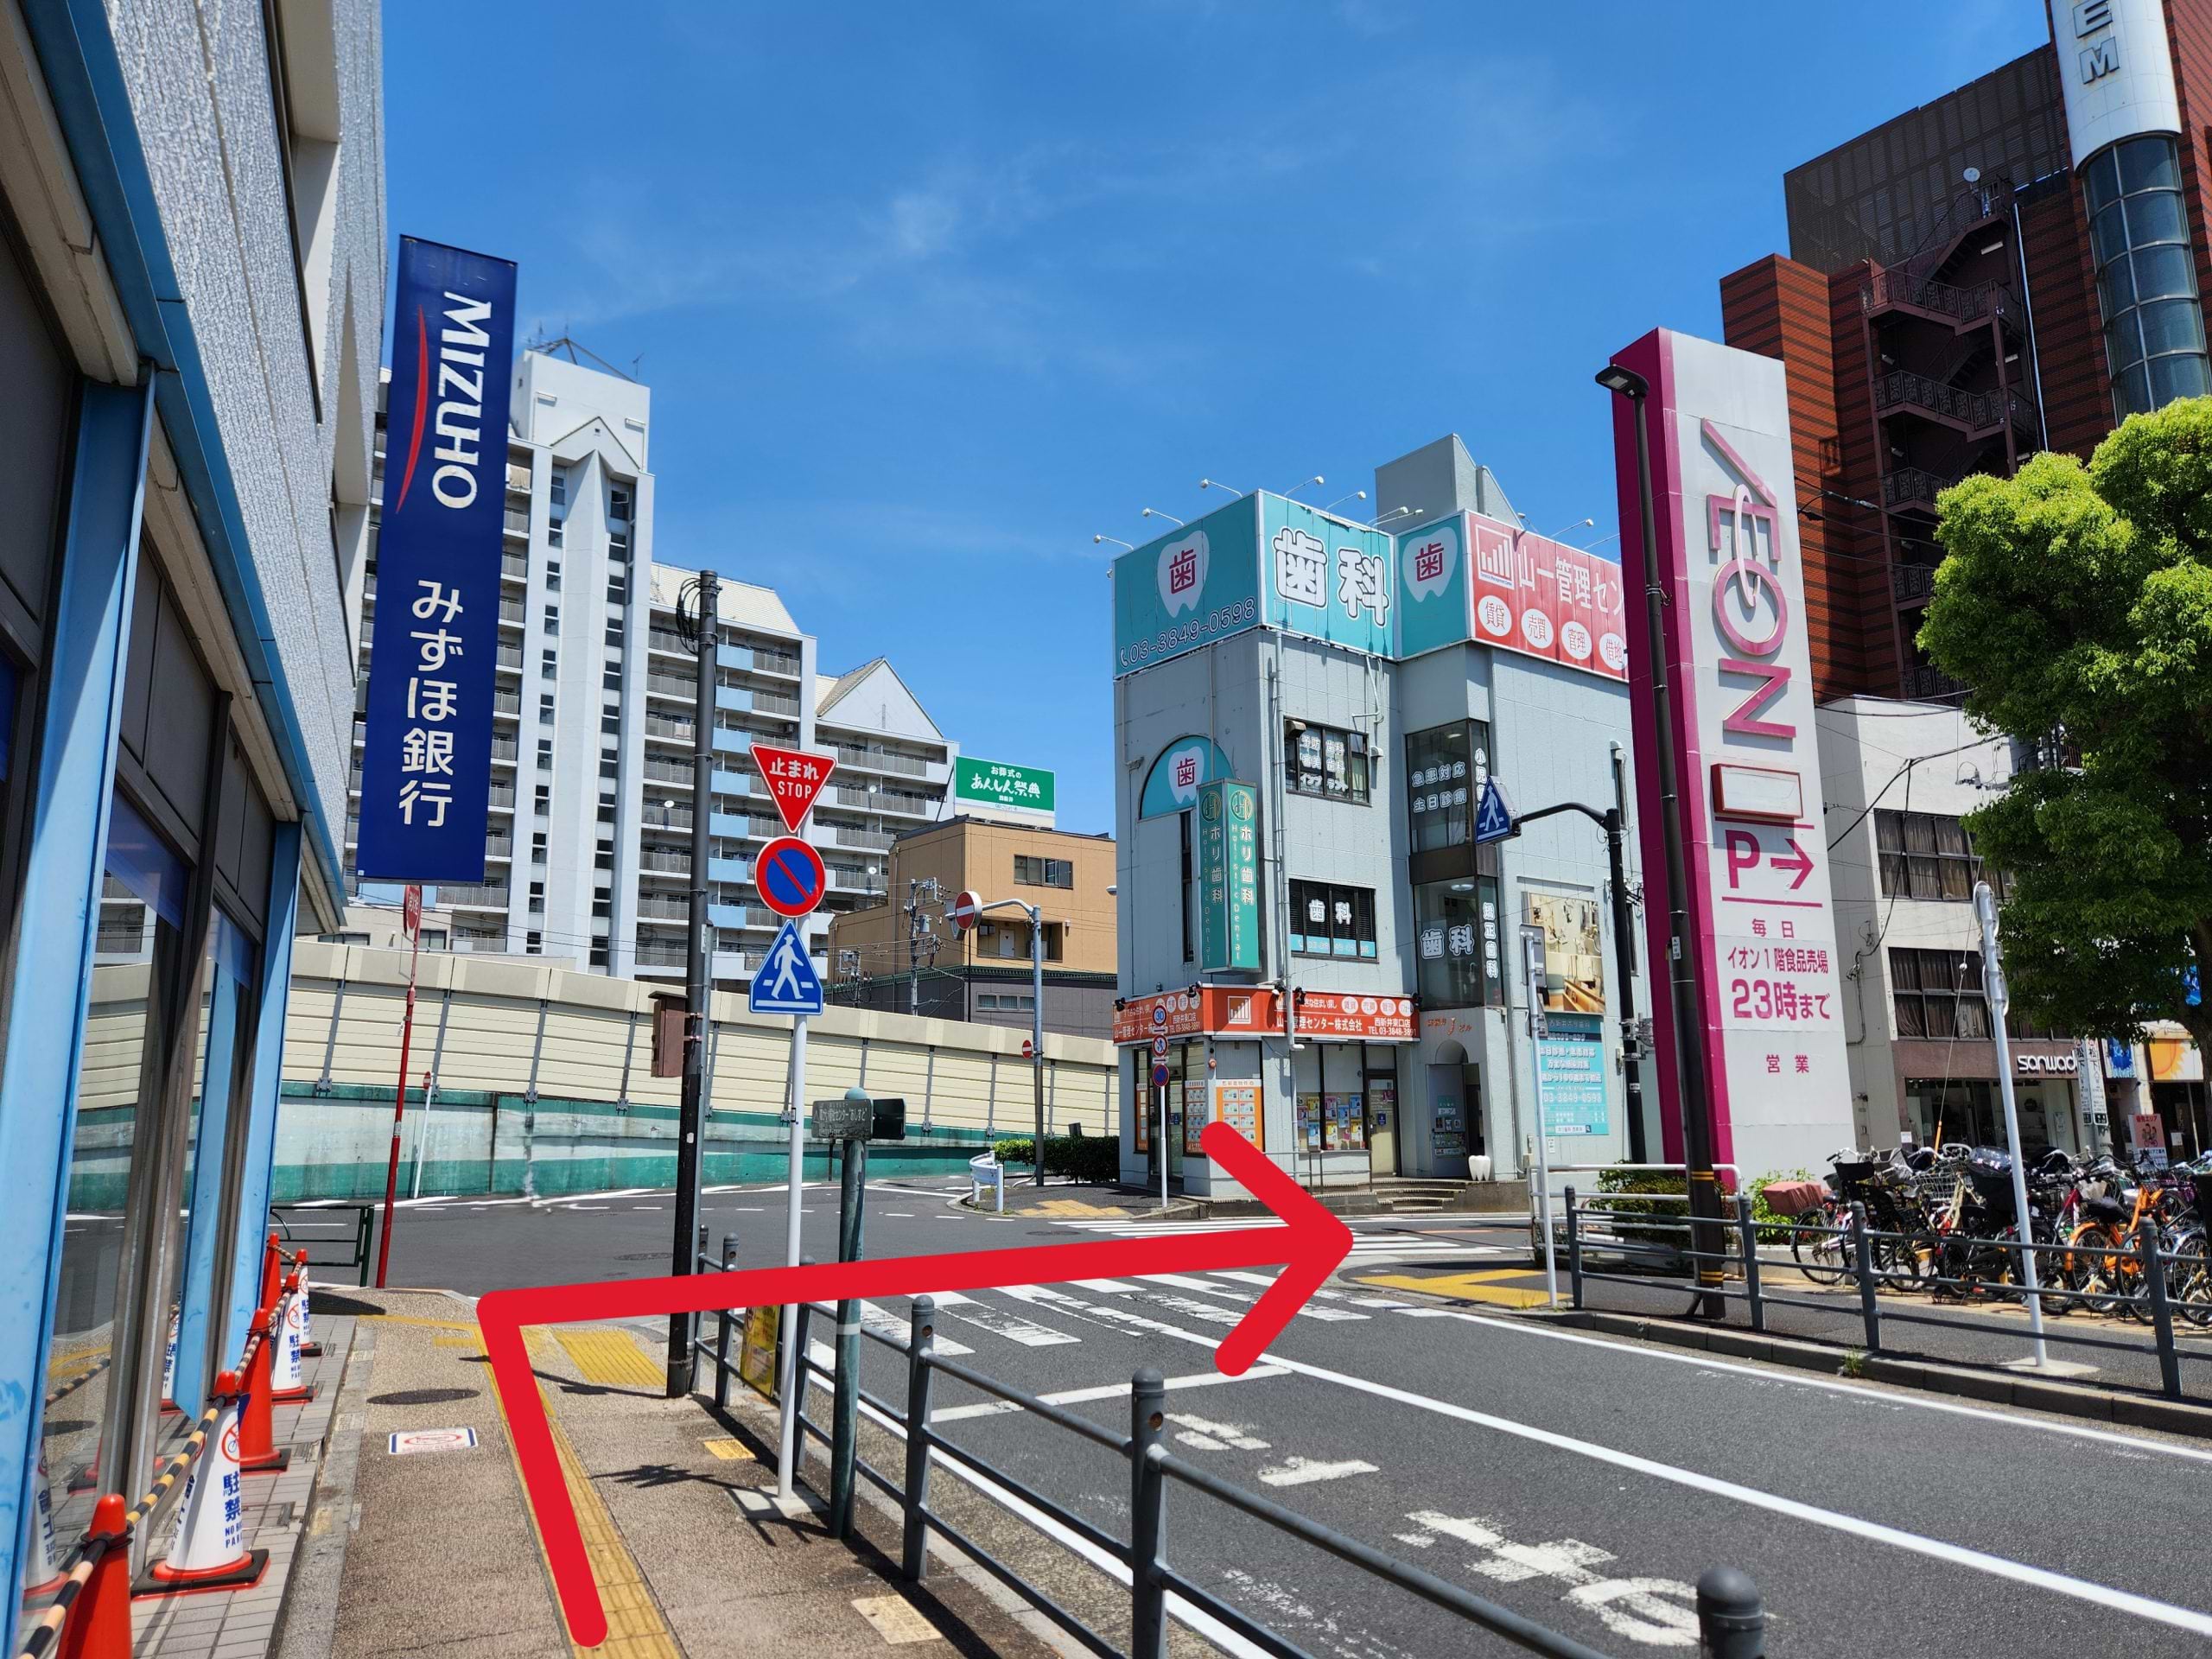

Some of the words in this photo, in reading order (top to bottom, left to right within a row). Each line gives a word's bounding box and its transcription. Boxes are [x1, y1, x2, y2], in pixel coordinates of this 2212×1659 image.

[433, 290, 493, 511] MIZUHO
[1169, 549, 1197, 594] 歯
[1272, 526, 1389, 627] 歯科
[1415, 542, 1444, 582] 歯
[1128, 596, 1255, 664] 03-3849-0598
[398, 579, 463, 828] みずほ銀行
[769, 757, 820, 781] 止まれ
[990, 766, 1022, 779] お葬式の
[1177, 757, 1196, 787] 歯
[1412, 761, 1466, 788] 急患対応
[778, 780, 812, 799] STOP
[970, 773, 1041, 799] あんしん祭典
[1413, 787, 1467, 813] 土日診療
[1211, 825, 1223, 906] ホリ歯科
[1241, 824, 1255, 906] ホリ歯科
[1725, 830, 1761, 889] P
[1308, 899, 1352, 925] 歯科
[1420, 925, 1474, 960] 歯科
[1483, 902, 1499, 979] 矯正歯科
[1751, 918, 1795, 939] 毎日
[1728, 946, 1828, 974] イオン1階食品売場
[1732, 978, 1831, 1022] 23時まで
[1368, 1026, 1378, 1035] TEL
[1374, 1018, 1411, 1027] 西新井東口店
[1765, 1054, 1810, 1073] 営業
[2017, 1050, 2078, 1071] sanwad
